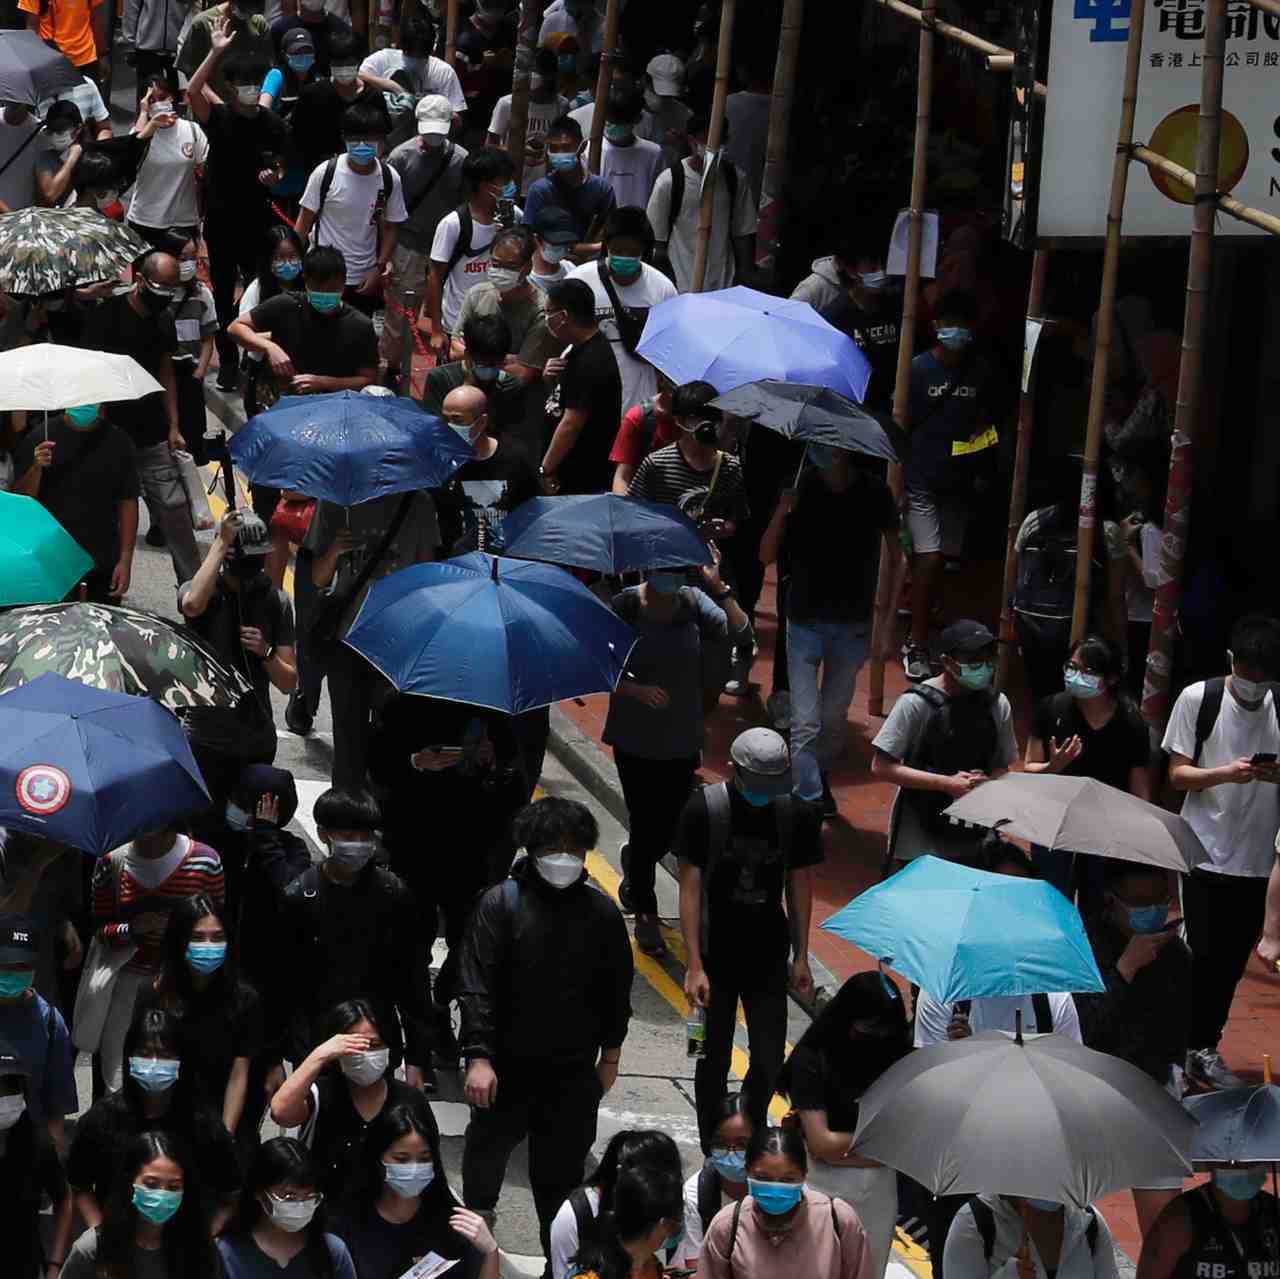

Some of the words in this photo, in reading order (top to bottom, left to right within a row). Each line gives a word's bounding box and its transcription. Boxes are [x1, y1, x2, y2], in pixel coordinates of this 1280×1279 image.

[1149, 52, 1279, 67] 香港上公司股
